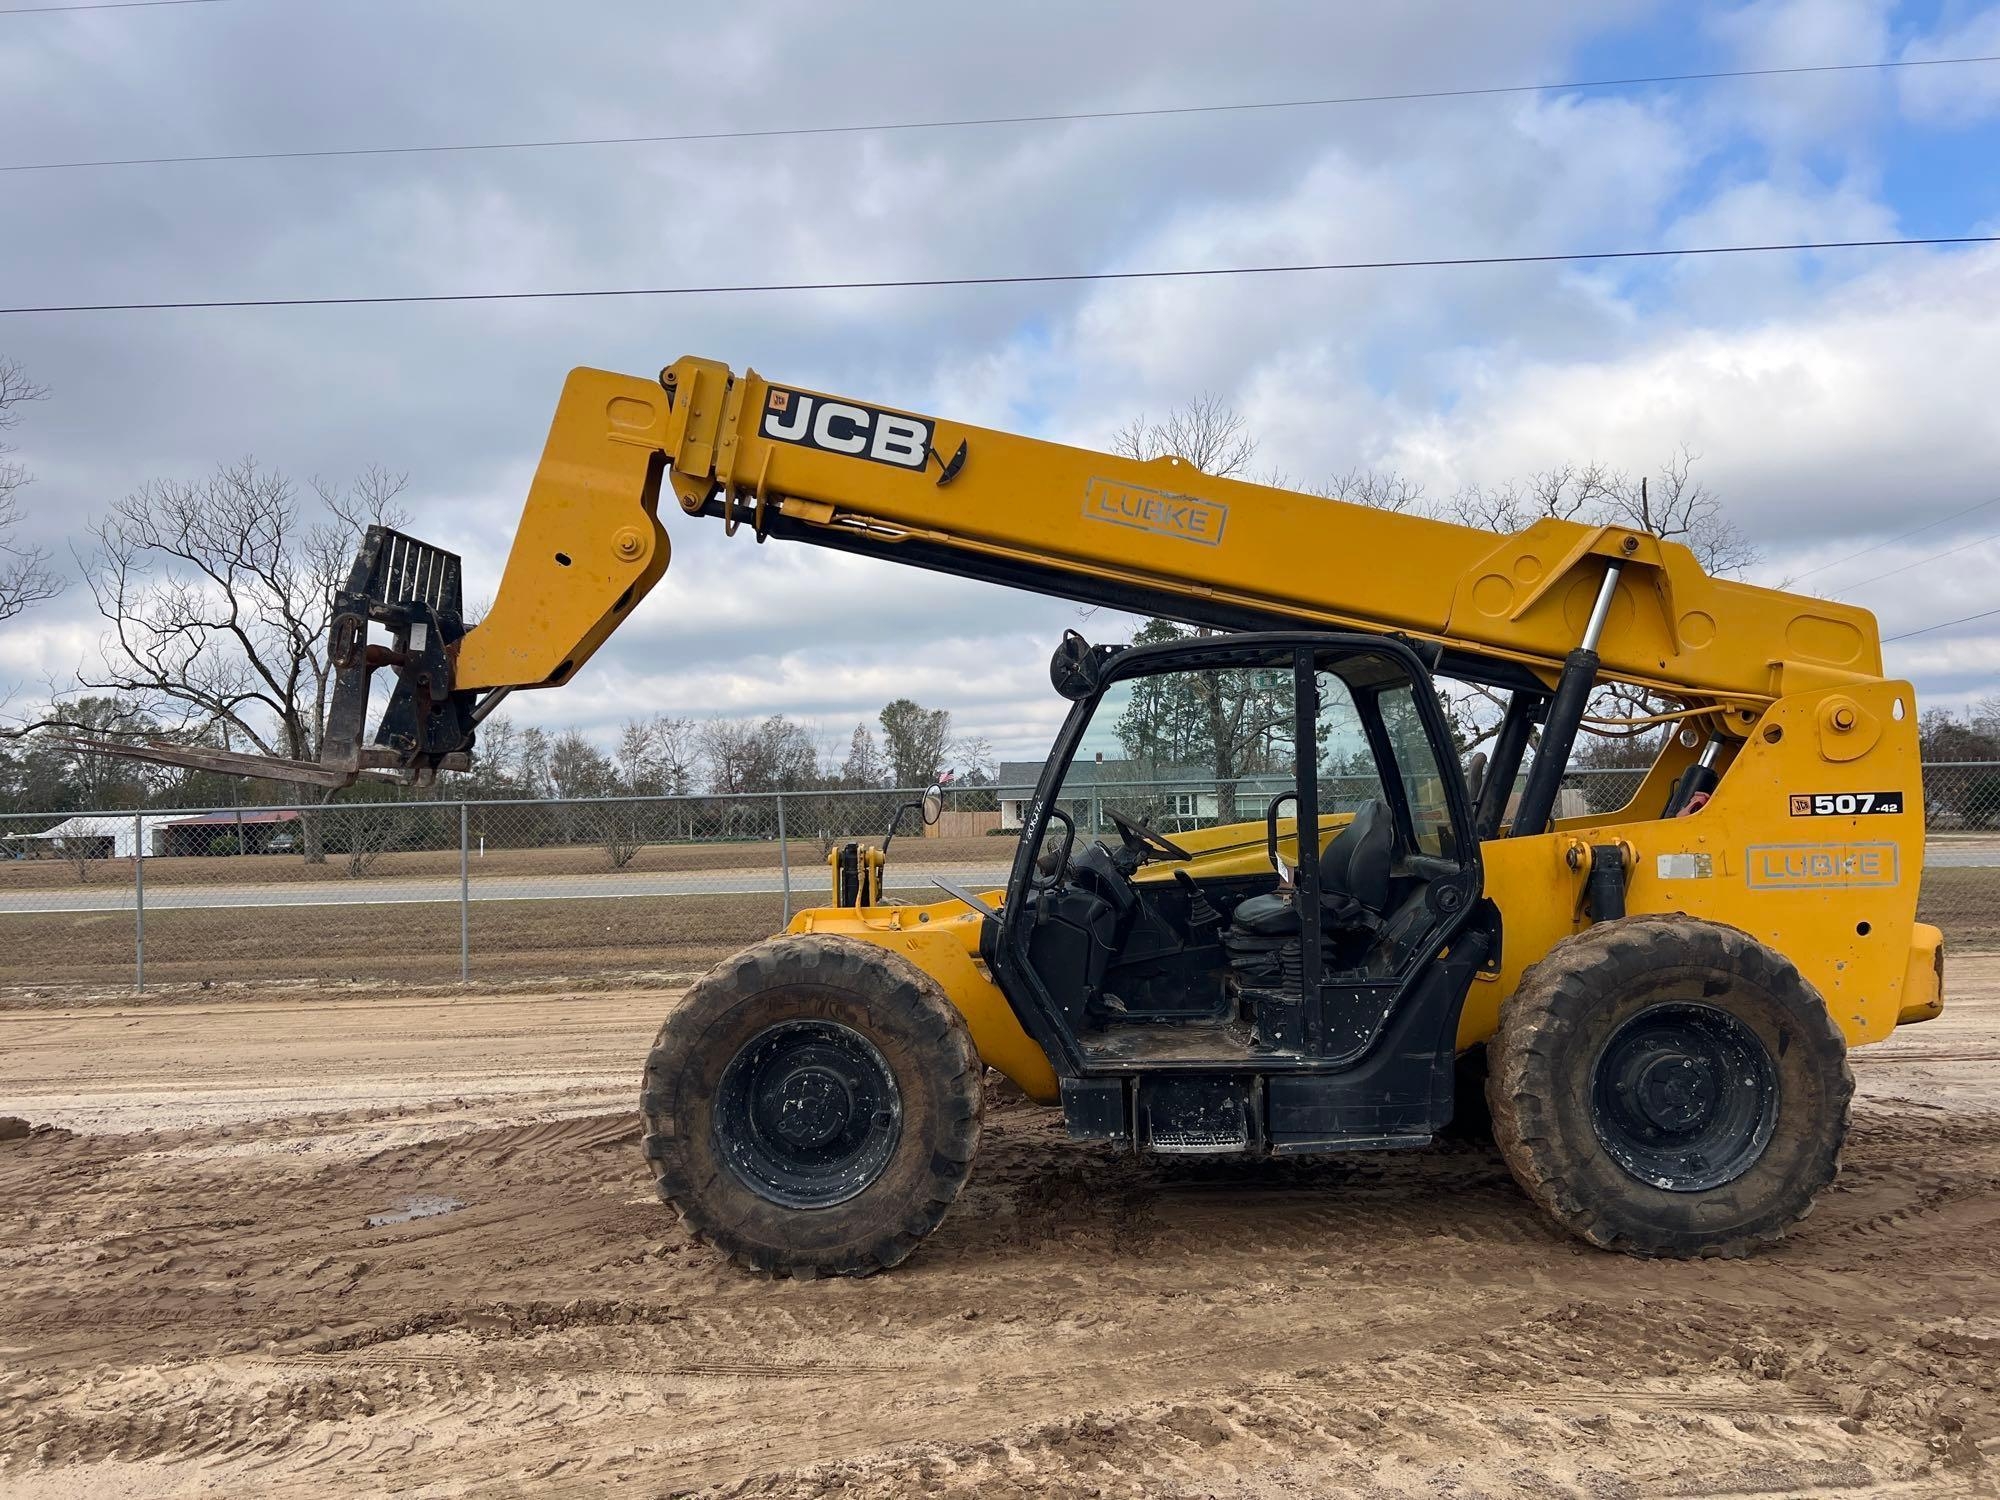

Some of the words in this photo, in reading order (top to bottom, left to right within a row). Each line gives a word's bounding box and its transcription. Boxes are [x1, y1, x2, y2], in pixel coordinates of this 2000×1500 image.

[765, 396, 928, 466] JCB
[1101, 489, 1209, 533] LUBKE
[1763, 852, 1880, 877] LUBKE
